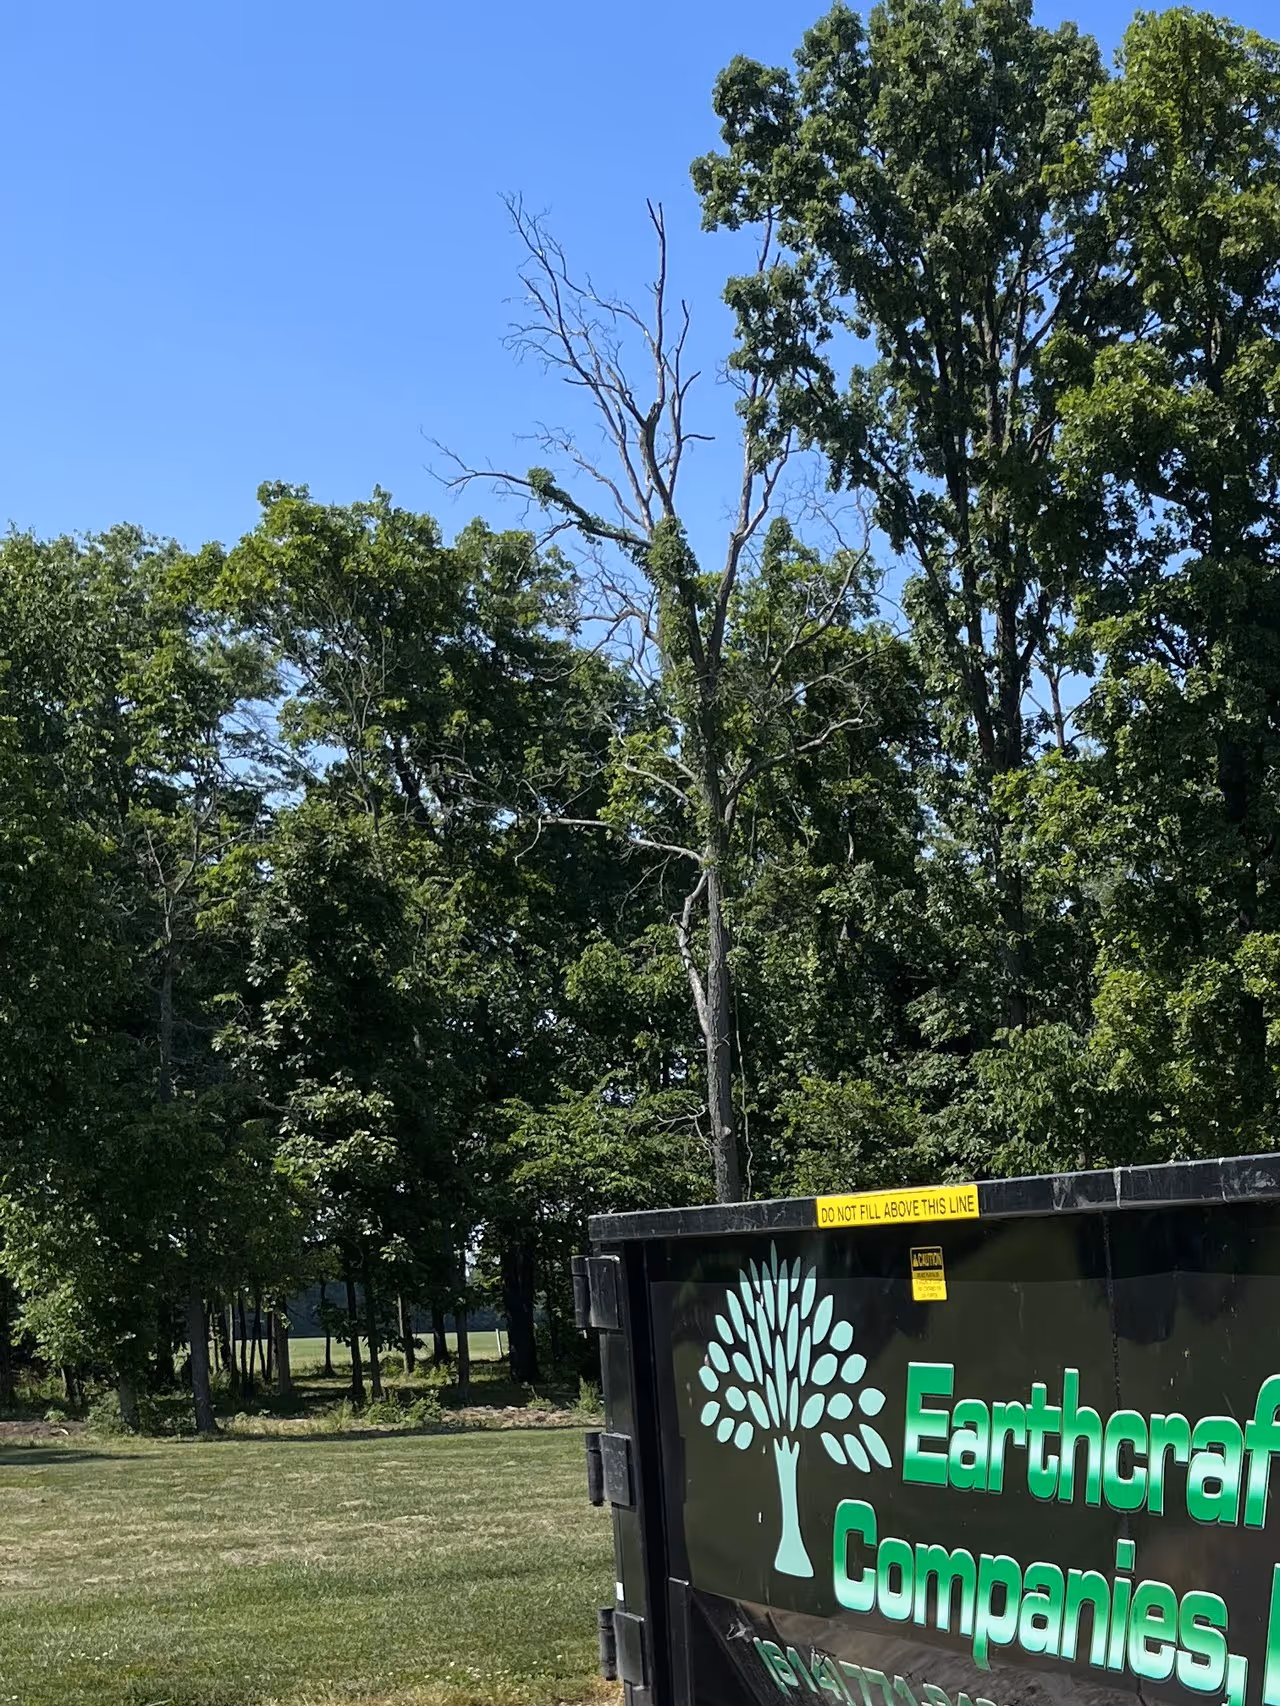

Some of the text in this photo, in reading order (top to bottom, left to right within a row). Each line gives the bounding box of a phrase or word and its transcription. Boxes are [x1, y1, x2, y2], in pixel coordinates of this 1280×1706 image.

[822, 1194, 975, 1223] DO NOT FILL ABOVE THIS LINE
